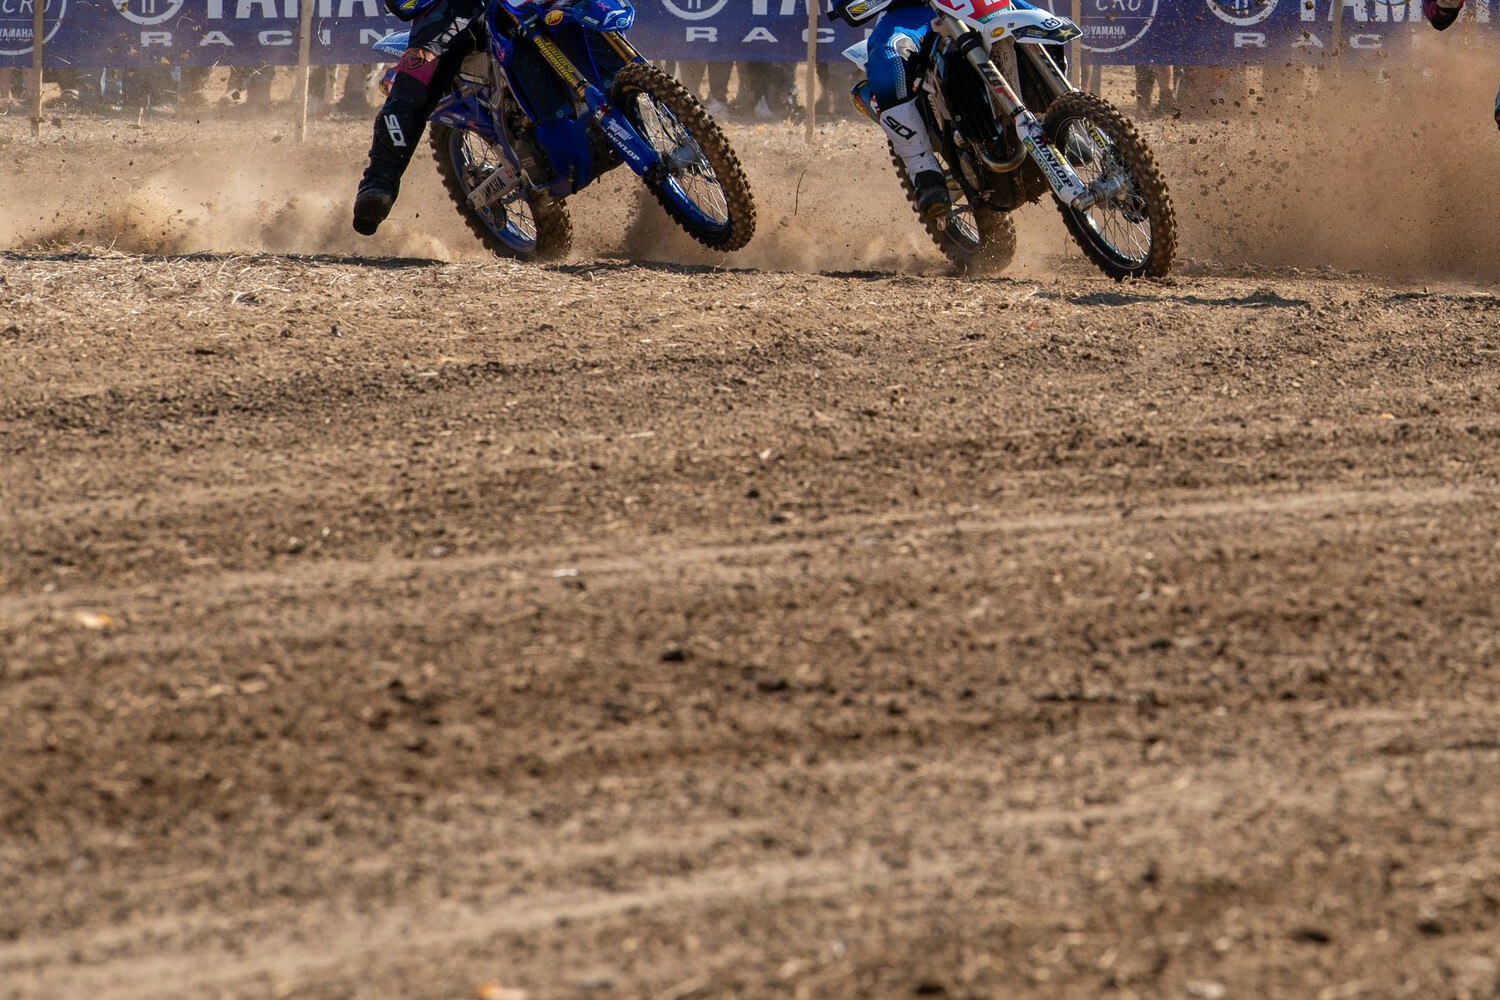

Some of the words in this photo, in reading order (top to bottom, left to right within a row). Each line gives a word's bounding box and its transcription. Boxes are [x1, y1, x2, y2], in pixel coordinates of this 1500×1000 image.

[140, 27, 395, 48] RACIN
[685, 26, 836, 43] RAC
[1090, 26, 1126, 36] YAMAHA
[383, 45, 406, 58] DUNLO
[607, 132, 641, 161] DUNLOP
[1033, 135, 1074, 188] DUNLOP
